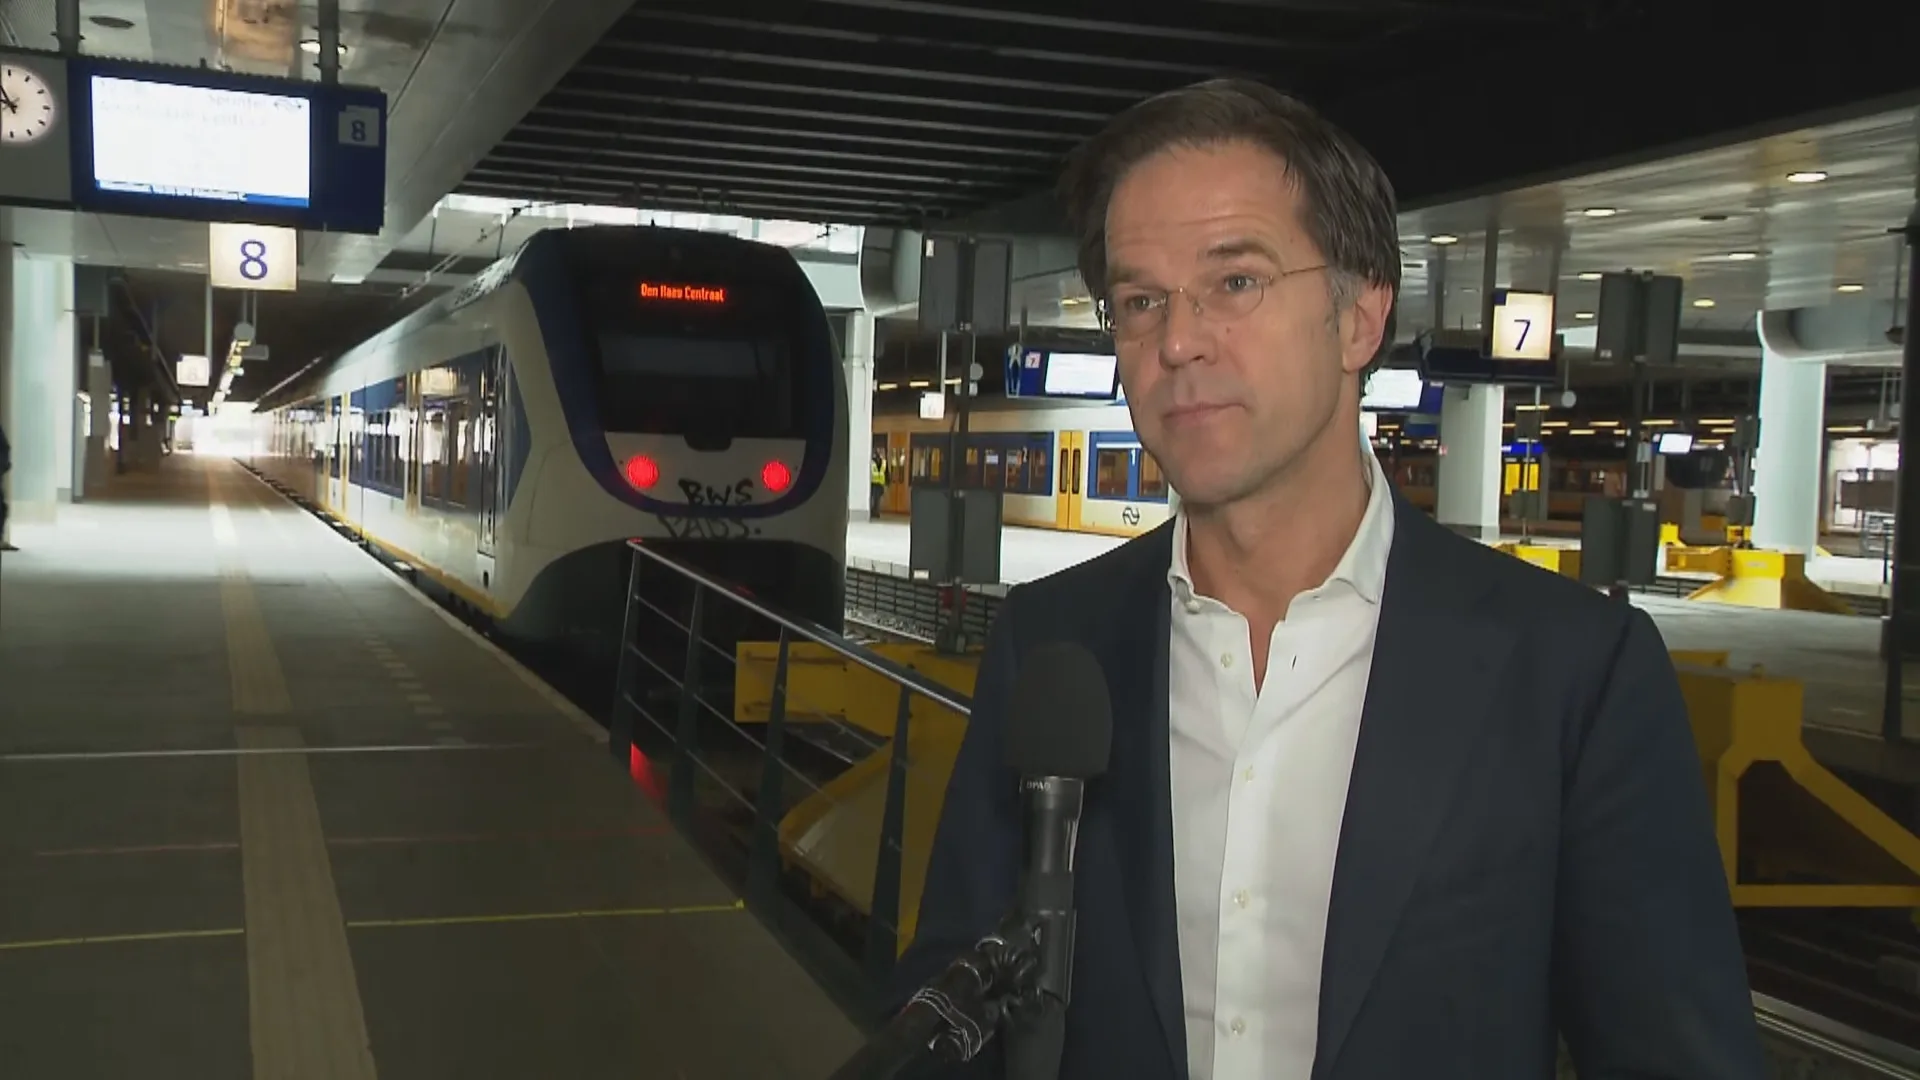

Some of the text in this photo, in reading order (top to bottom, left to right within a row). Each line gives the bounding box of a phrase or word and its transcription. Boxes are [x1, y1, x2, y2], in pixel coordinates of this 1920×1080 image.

[351, 119, 366, 142] 8
[240, 240, 268, 280] 8
[1513, 319, 1531, 351] 7
[678, 477, 754, 507] BWS
